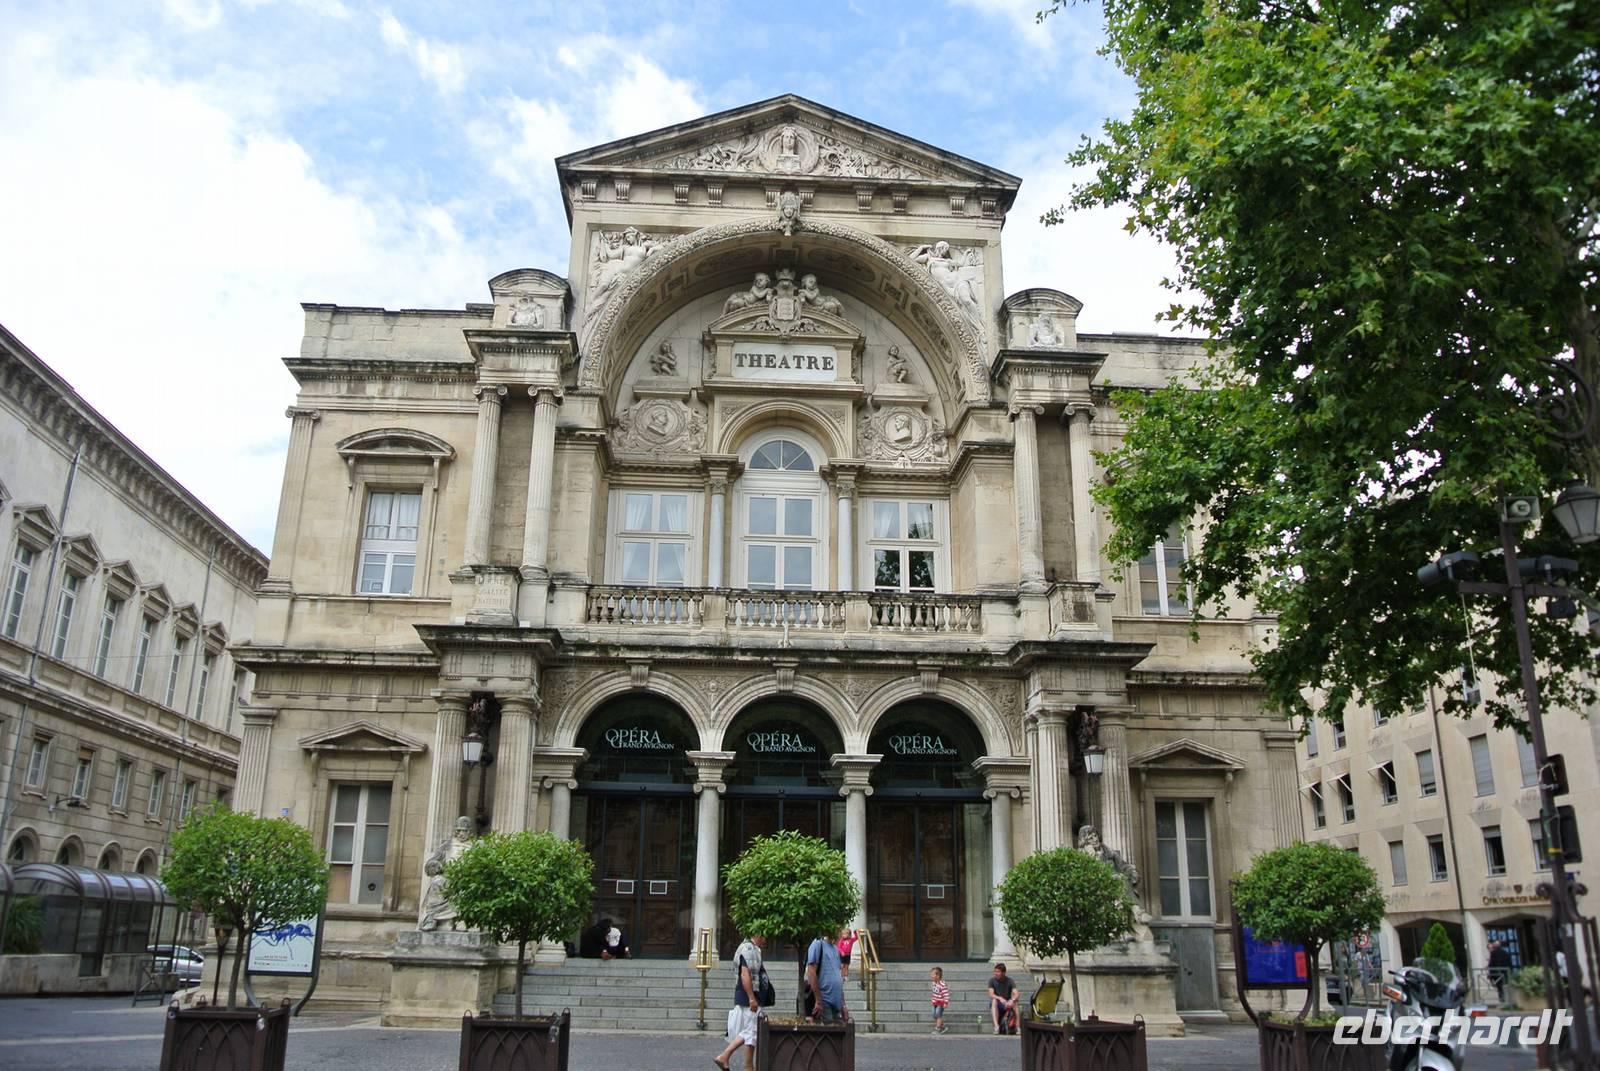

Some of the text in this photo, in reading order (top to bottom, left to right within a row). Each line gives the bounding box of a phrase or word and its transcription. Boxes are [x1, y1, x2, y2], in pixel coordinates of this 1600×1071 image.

[735, 354, 834, 370] THEATRE
[605, 727, 661, 743] OPÉRA
[610, 736, 642, 748] GRAND
[747, 731, 802, 747] OPÉRA
[889, 733, 944, 749] OPÉRA
[752, 740, 784, 752] GRAND
[894, 742, 925, 754] GRAND
